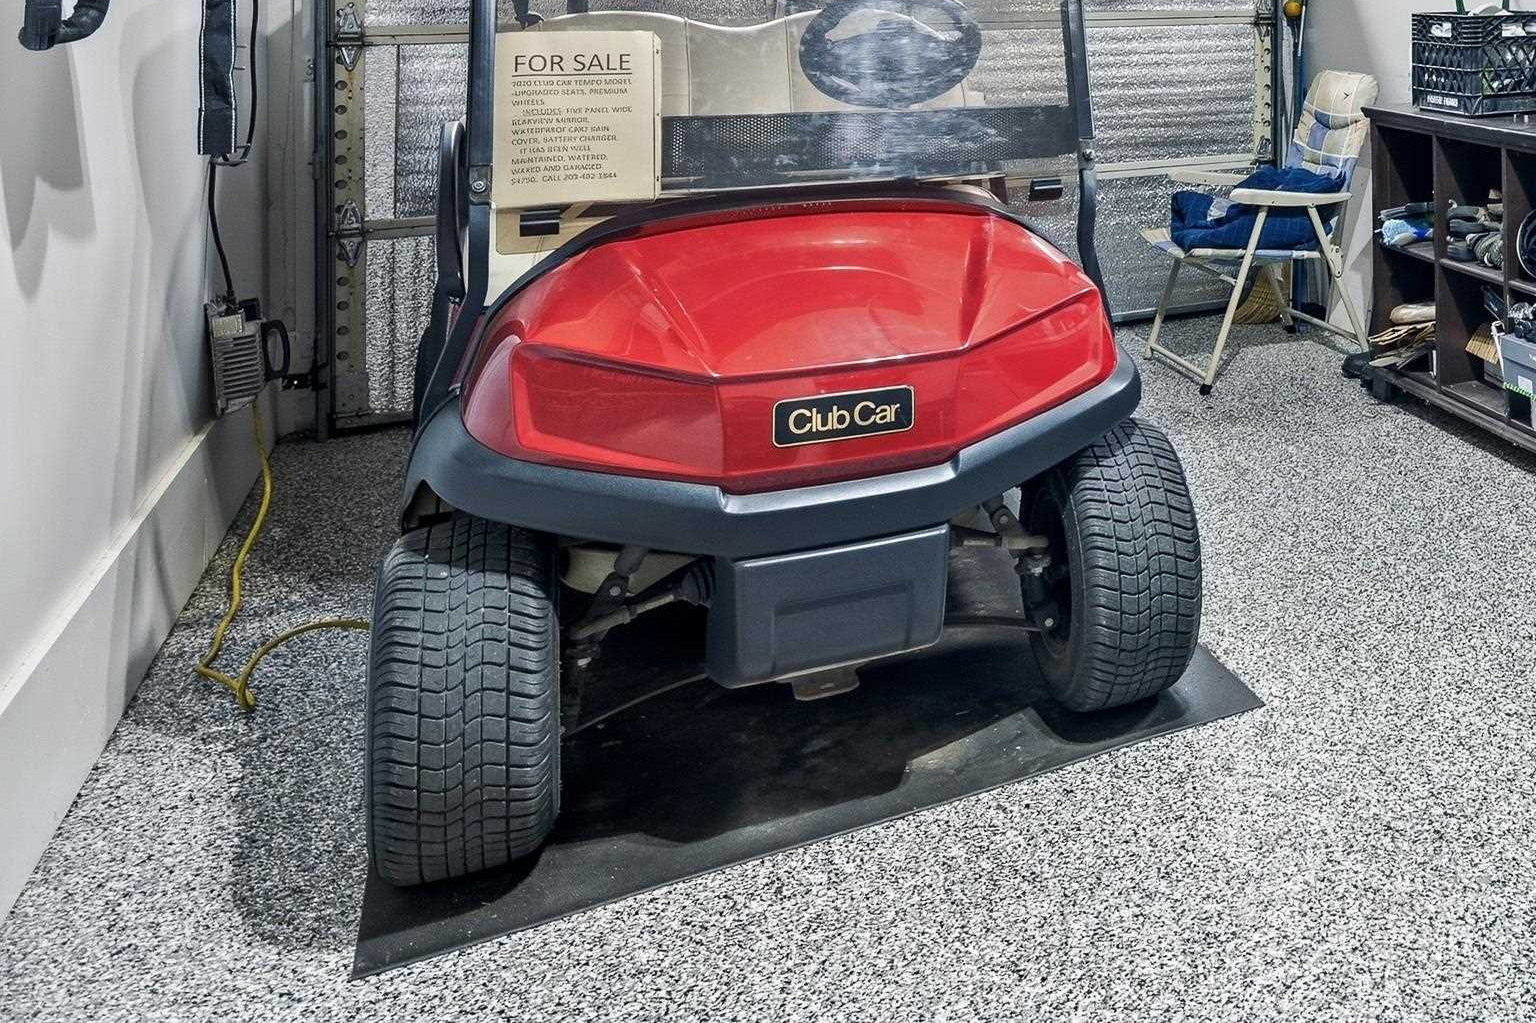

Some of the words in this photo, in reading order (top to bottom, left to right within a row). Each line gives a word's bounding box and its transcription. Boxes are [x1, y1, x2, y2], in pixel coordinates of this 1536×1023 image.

[514, 54, 565, 73] FOR
[573, 53, 632, 72] SALE
[511, 126, 566, 135] WATERPROOF
[543, 164, 561, 172] AND
[542, 175, 561, 183] CALL
[788, 404, 851, 435] Club
[853, 400, 900, 426] Car
